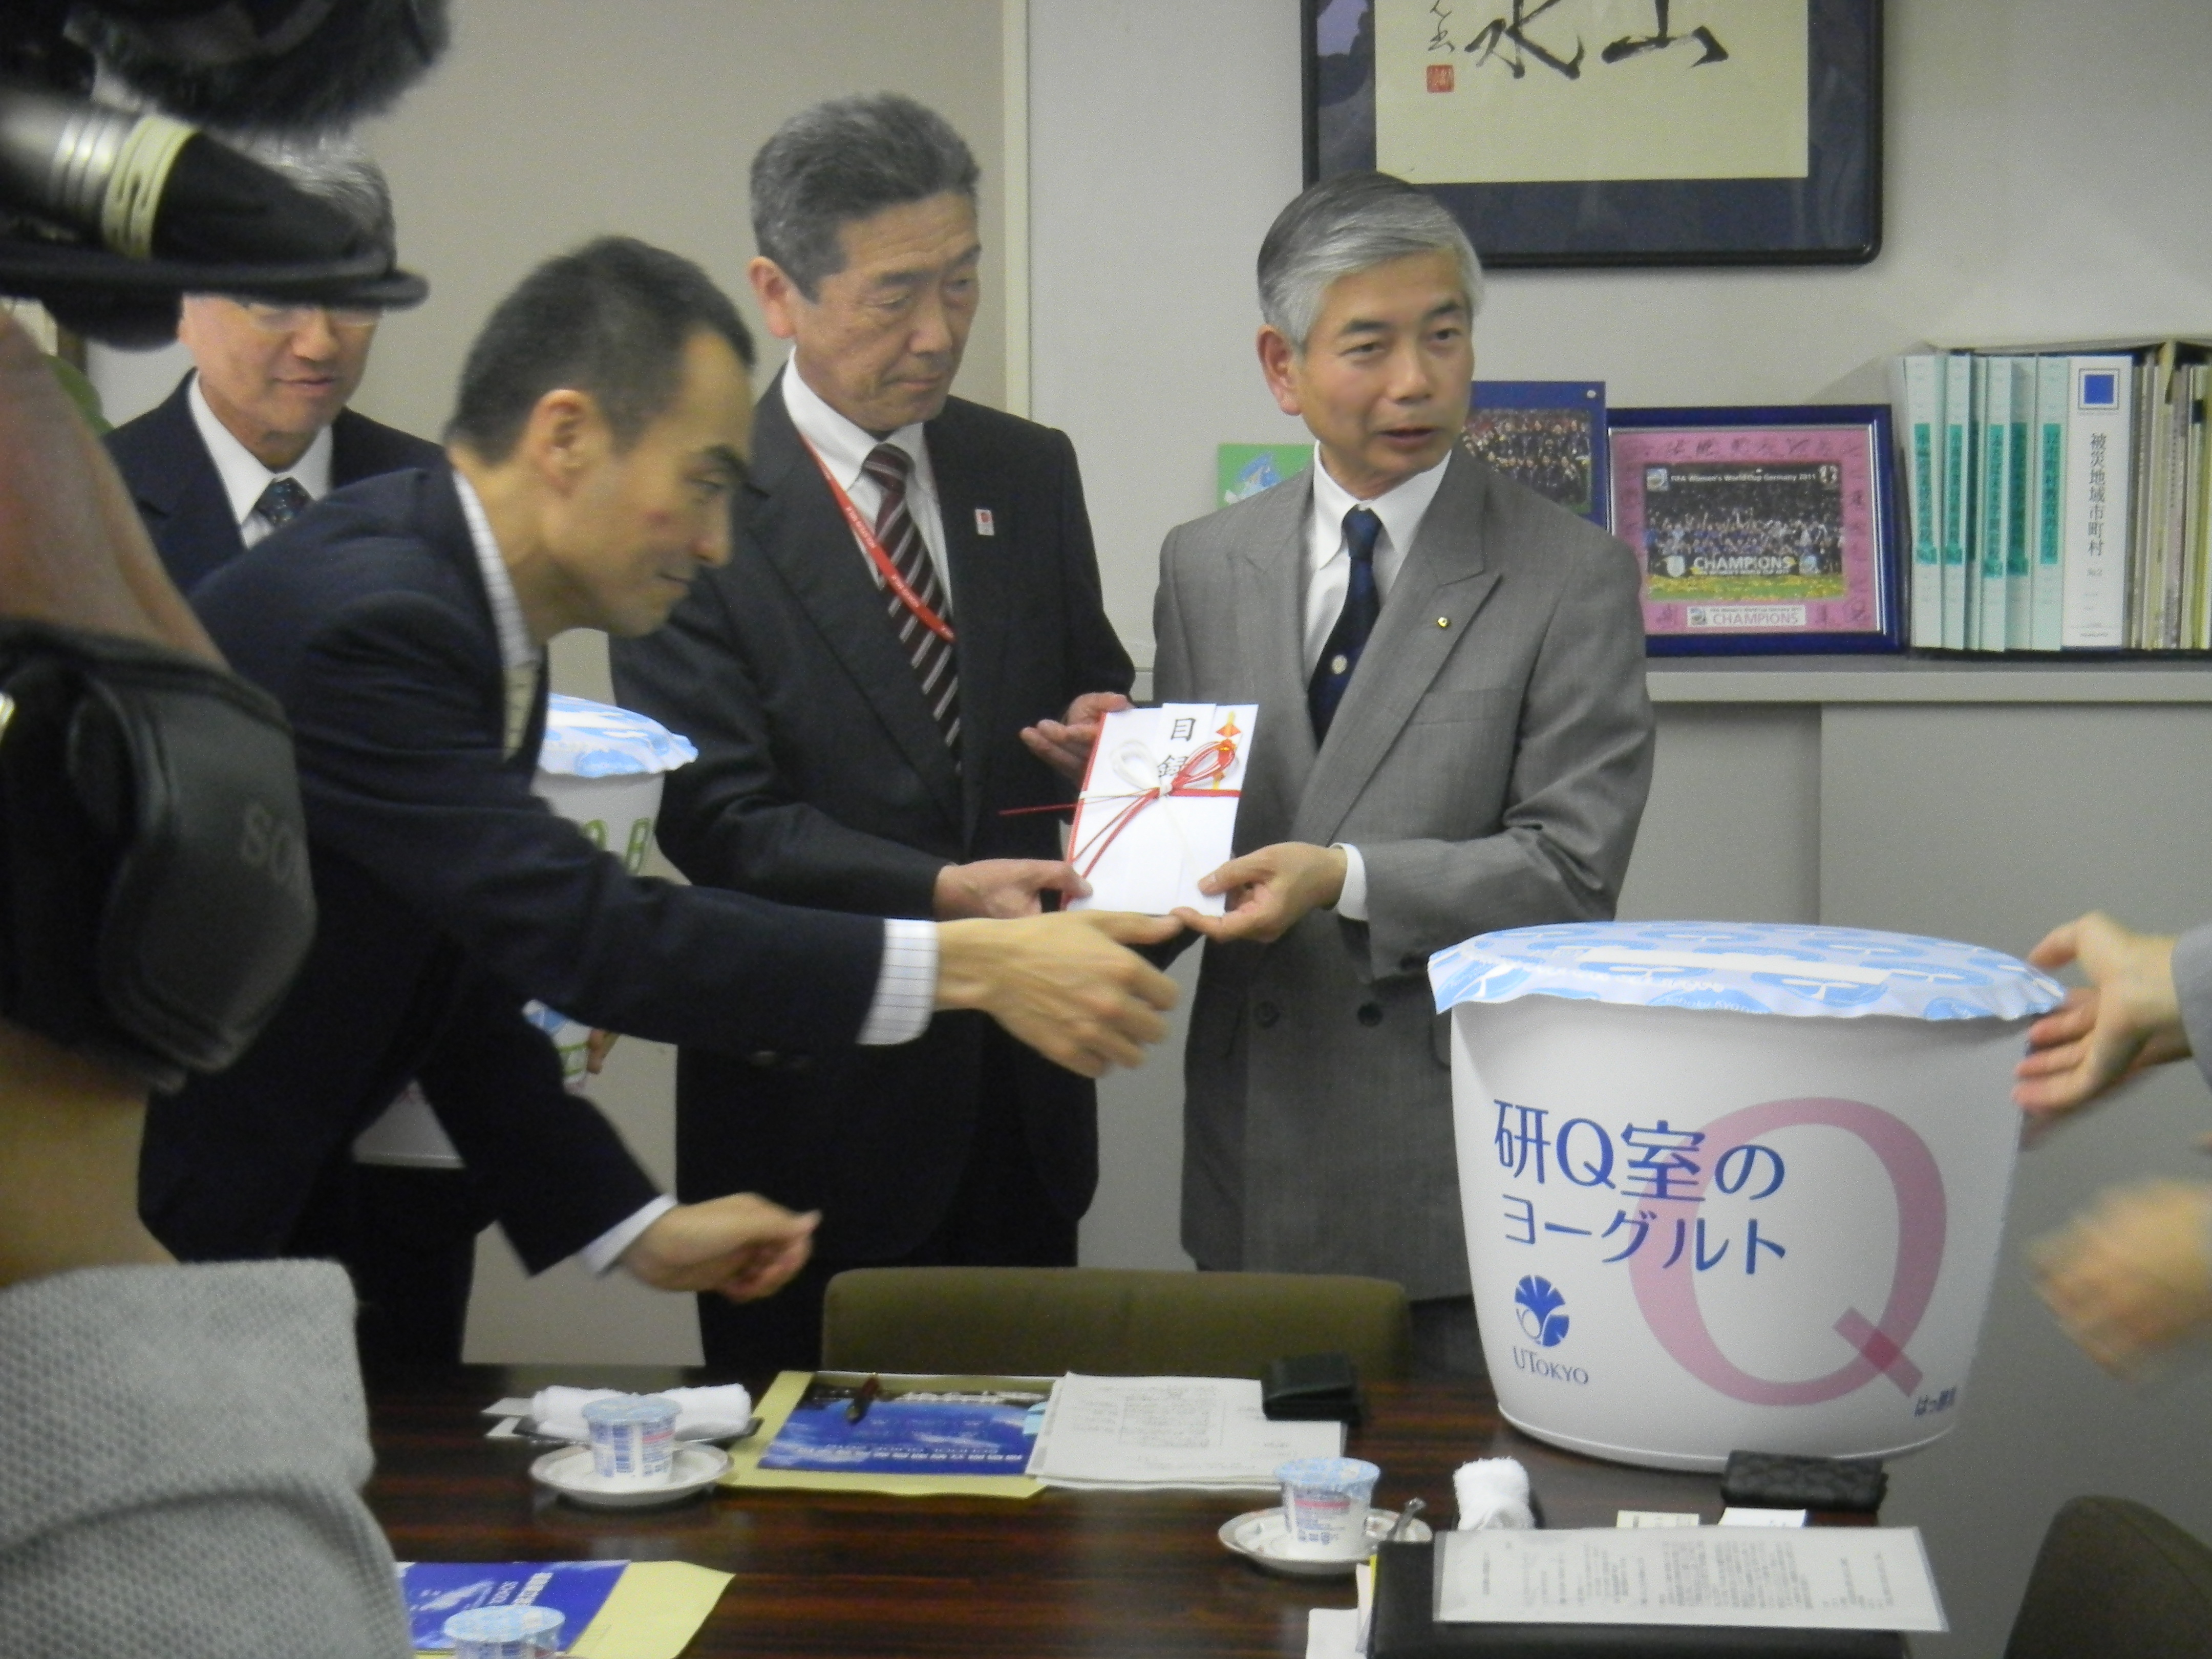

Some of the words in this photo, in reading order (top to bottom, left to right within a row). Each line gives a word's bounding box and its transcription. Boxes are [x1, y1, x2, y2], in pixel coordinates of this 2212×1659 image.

[1693, 556, 1795, 570] CHAMPIONS
[1713, 613, 1799, 625] CHAMPIONS
[1494, 1099, 1785, 1202] 研Q室の
[1502, 1194, 1786, 1275] ヨーグルト
[1628, 1097, 1947, 1406] Q
